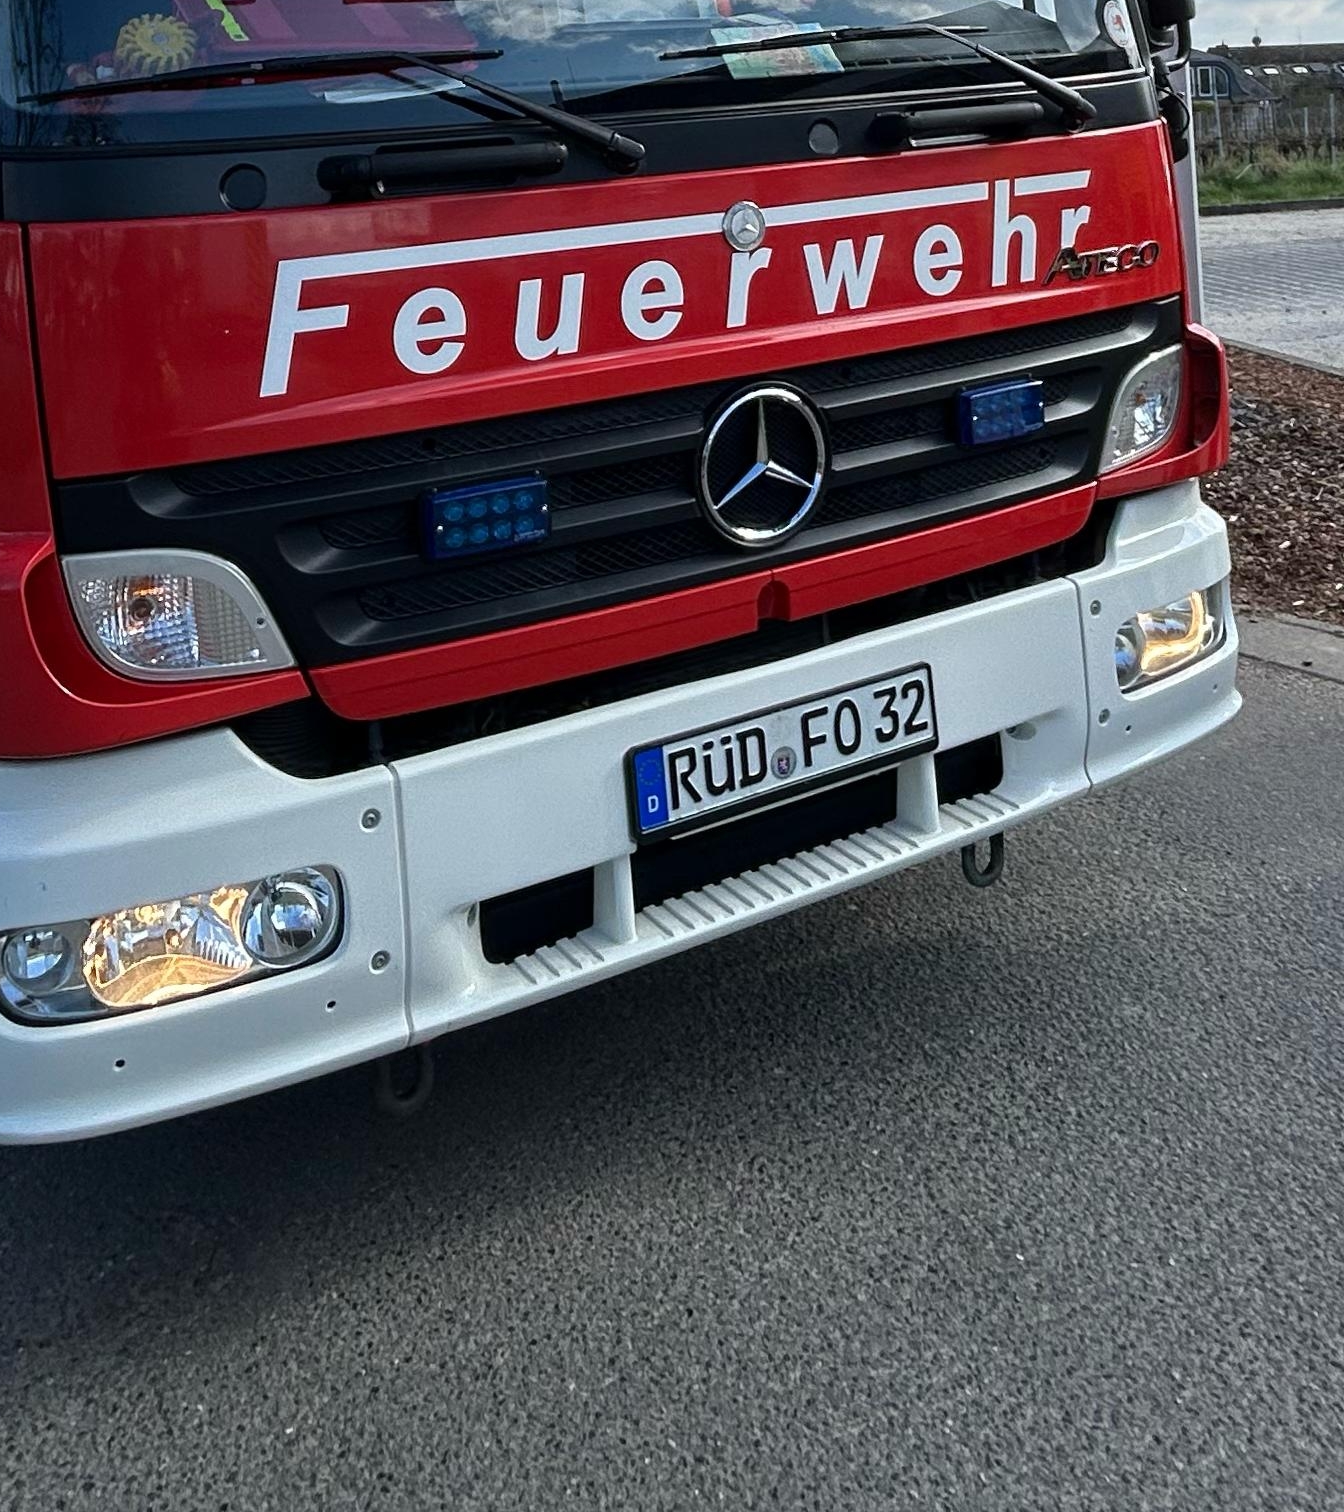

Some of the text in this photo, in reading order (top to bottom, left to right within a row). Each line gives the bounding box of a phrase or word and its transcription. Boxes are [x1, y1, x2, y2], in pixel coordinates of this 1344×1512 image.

[259, 169, 1091, 398] Feuerwehr
[647, 678, 929, 814] D RÜD FO 32
